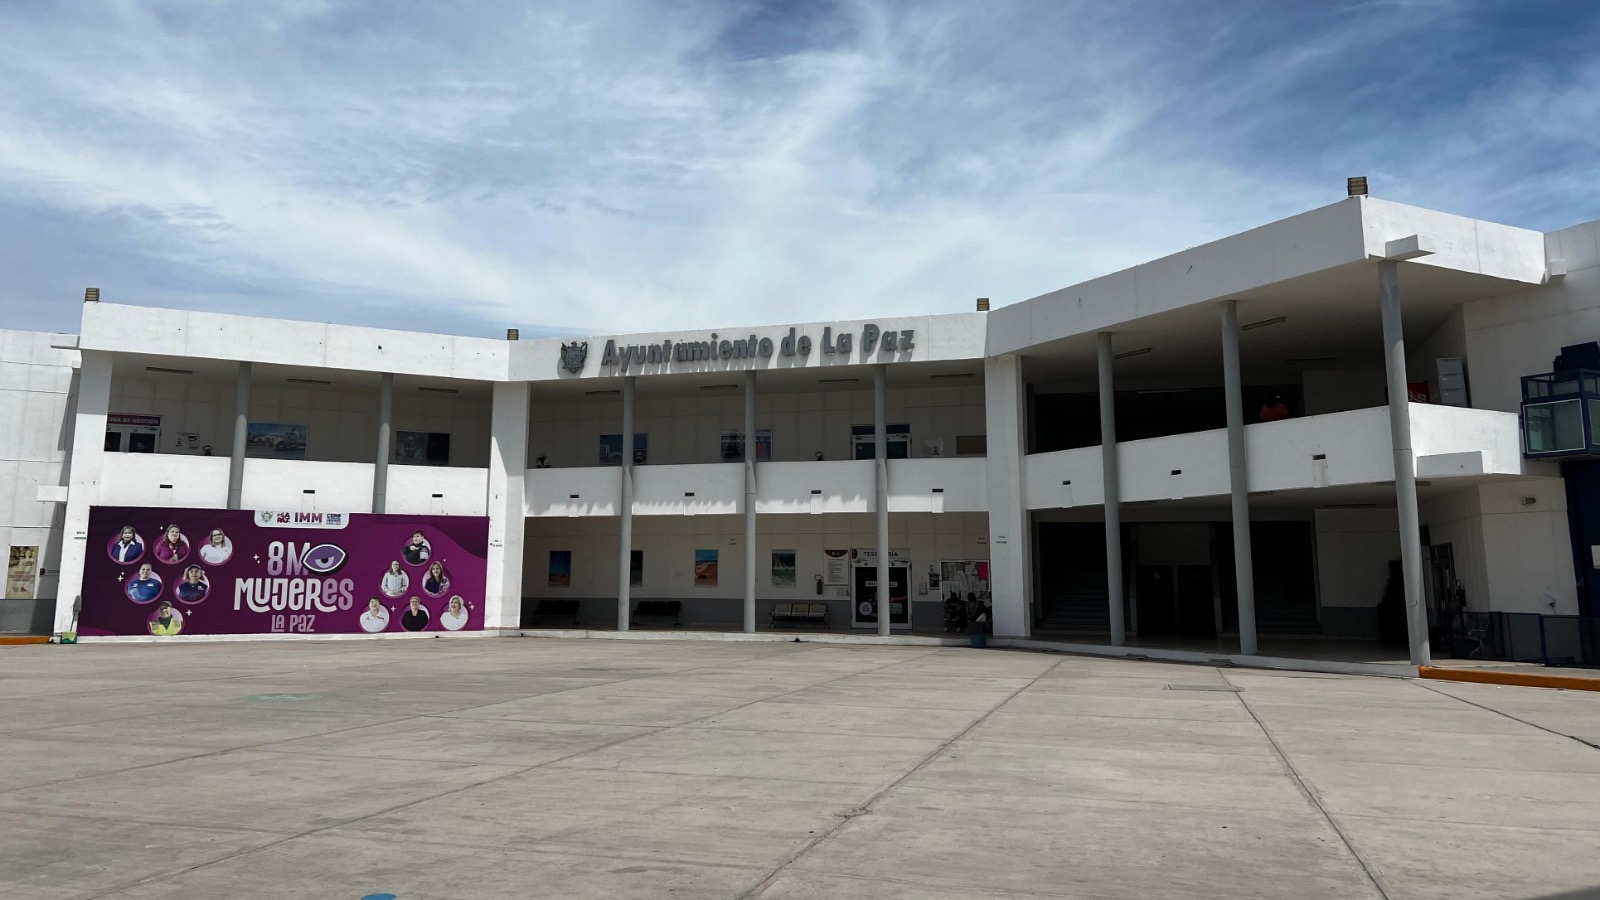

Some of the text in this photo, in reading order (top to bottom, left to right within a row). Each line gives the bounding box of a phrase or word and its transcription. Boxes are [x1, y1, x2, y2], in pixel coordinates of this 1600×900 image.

[601, 323, 915, 372] Ayuntamiento de La Paz
[294, 512, 323, 523] IMM
[267, 541, 311, 576] 8M
[271, 614, 285, 633] LA
